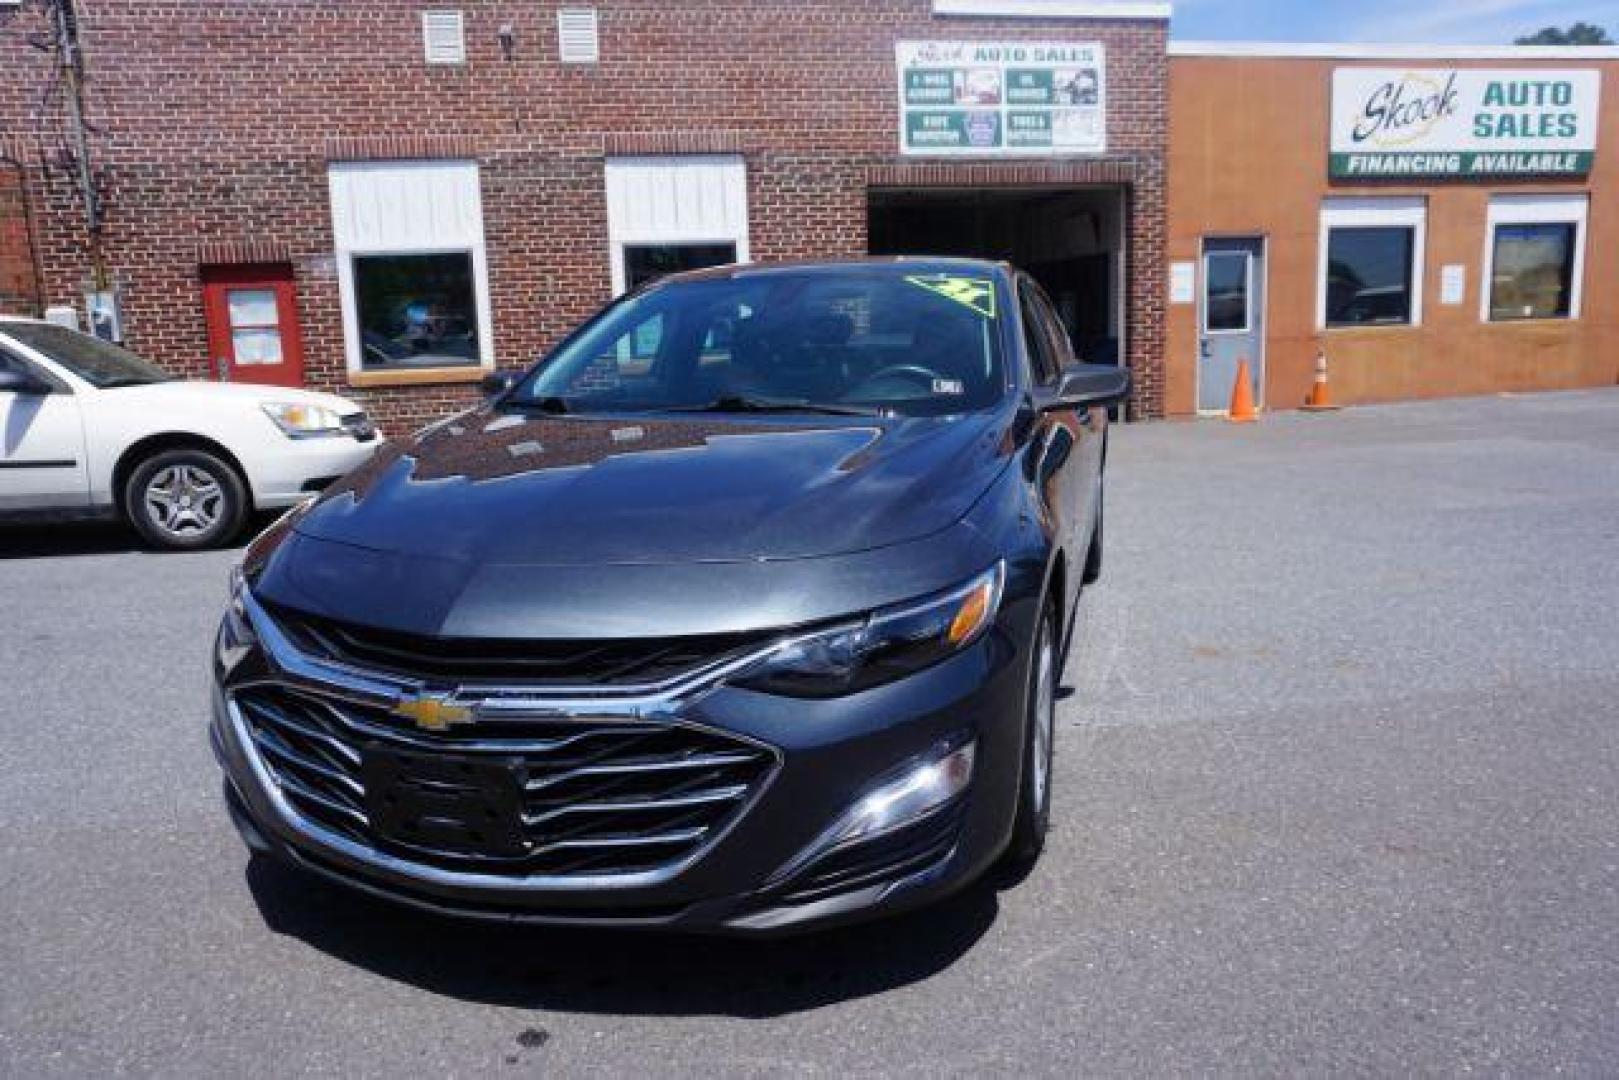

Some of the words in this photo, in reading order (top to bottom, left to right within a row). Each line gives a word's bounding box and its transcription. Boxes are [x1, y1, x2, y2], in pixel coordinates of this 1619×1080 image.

[1351, 69, 1458, 142] Skook
[1482, 80, 1573, 107] AUTO
[1472, 113, 1578, 139] SALES
[1347, 154, 1461, 174] FINANCING
[1470, 153, 1579, 173] AVAILABLE
